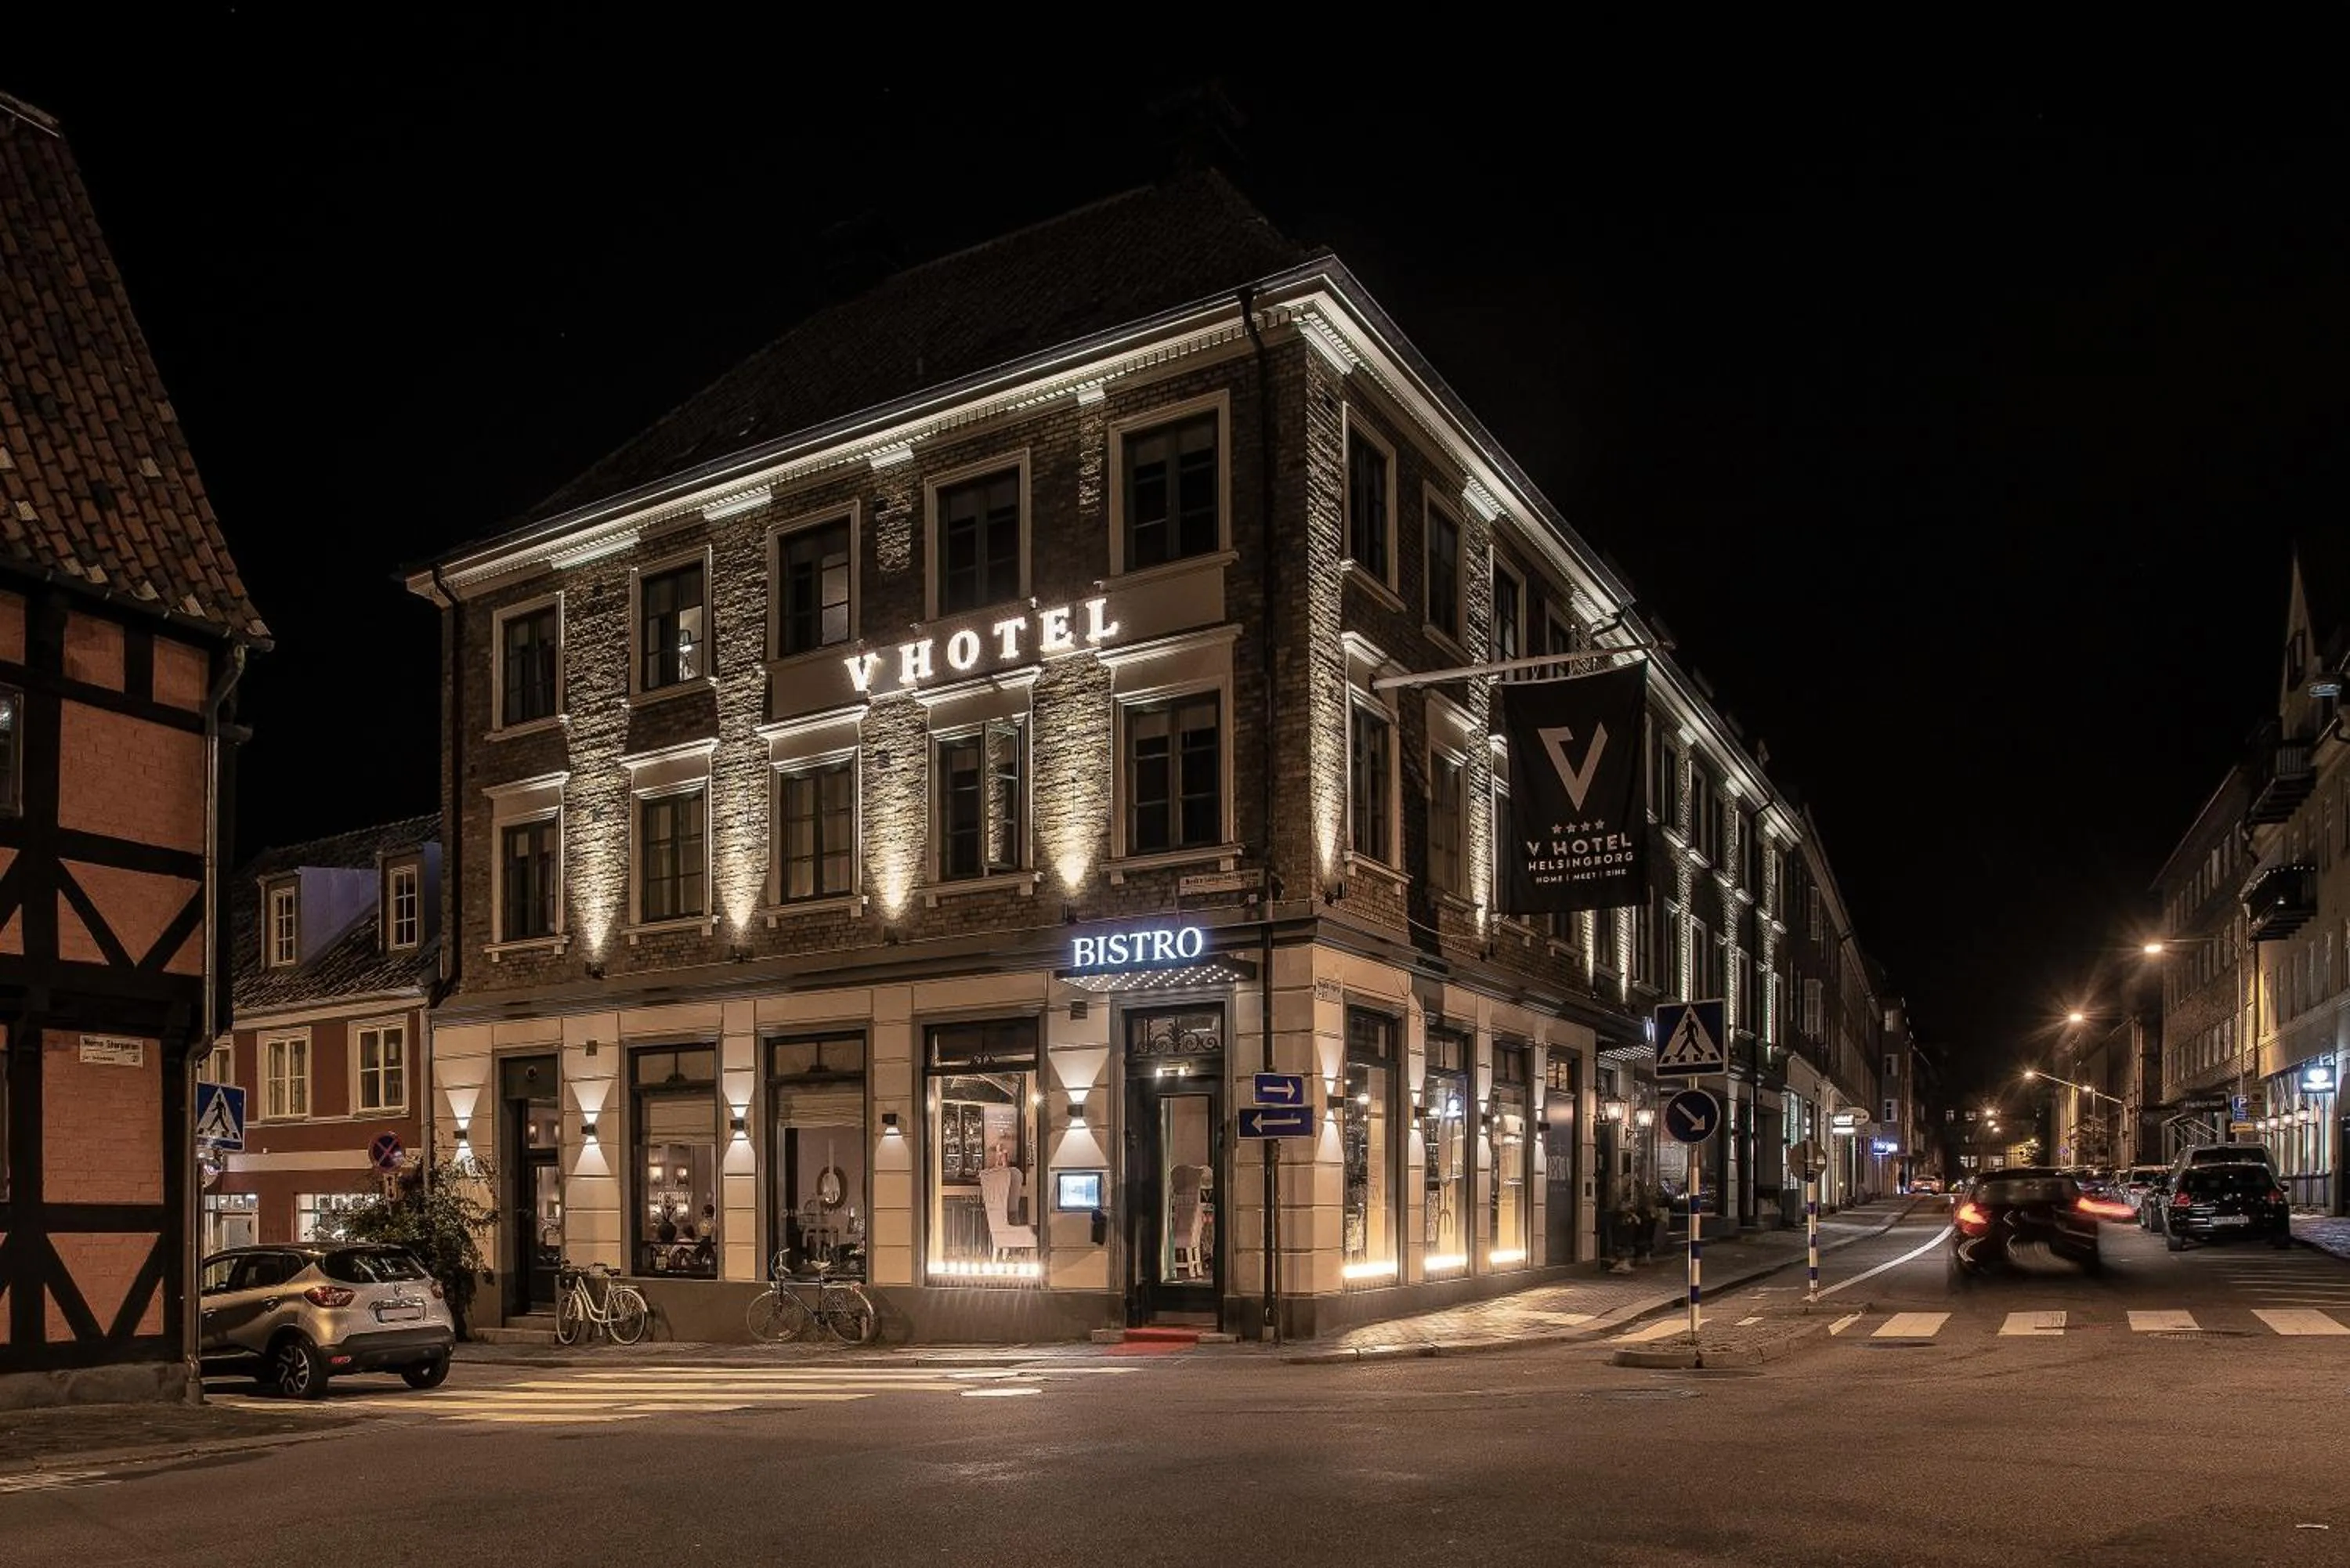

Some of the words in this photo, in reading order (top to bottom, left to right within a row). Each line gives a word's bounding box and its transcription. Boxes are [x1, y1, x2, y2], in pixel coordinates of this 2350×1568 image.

[844, 652, 880, 692] V
[898, 598, 1119, 684] HOTEL
[1538, 721, 1608, 812] V
[1527, 840, 1540, 857] V
[1553, 832, 1632, 855] HOTEL
[1528, 851, 1633, 872] HELSINGBORG
[1536, 875, 1563, 883] HOME
[1072, 927, 1202, 967] BISTRO
[2238, 1097, 2247, 1108] P
